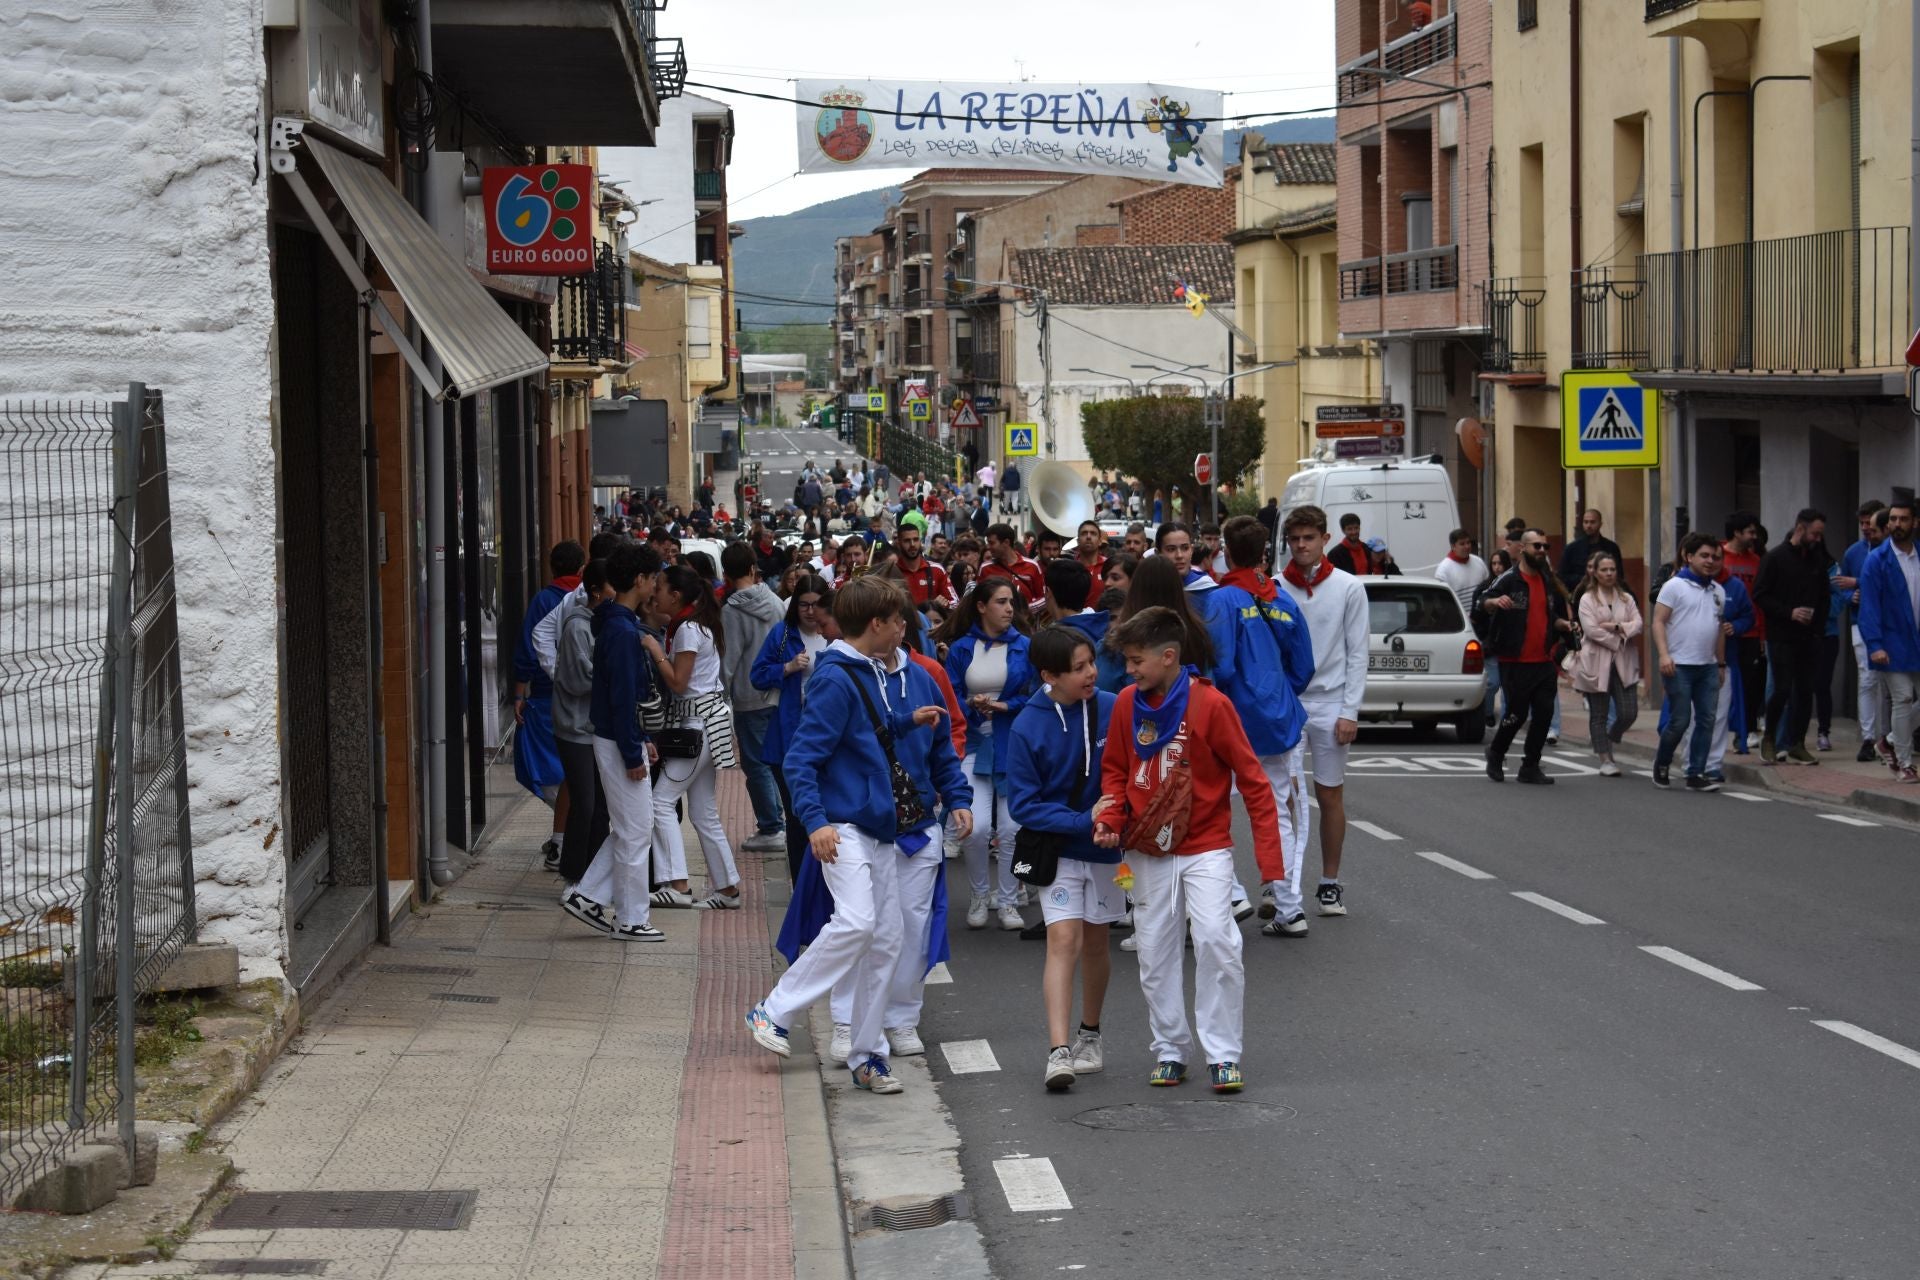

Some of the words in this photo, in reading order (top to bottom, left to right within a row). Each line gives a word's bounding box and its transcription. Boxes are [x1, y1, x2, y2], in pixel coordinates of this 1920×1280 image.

[894, 88, 946, 131] LA
[960, 88, 1135, 140] REPEÑA
[492, 249, 537, 263] EURO
[541, 248, 588, 263] 6000
[1154, 824, 1169, 847] NIKE
